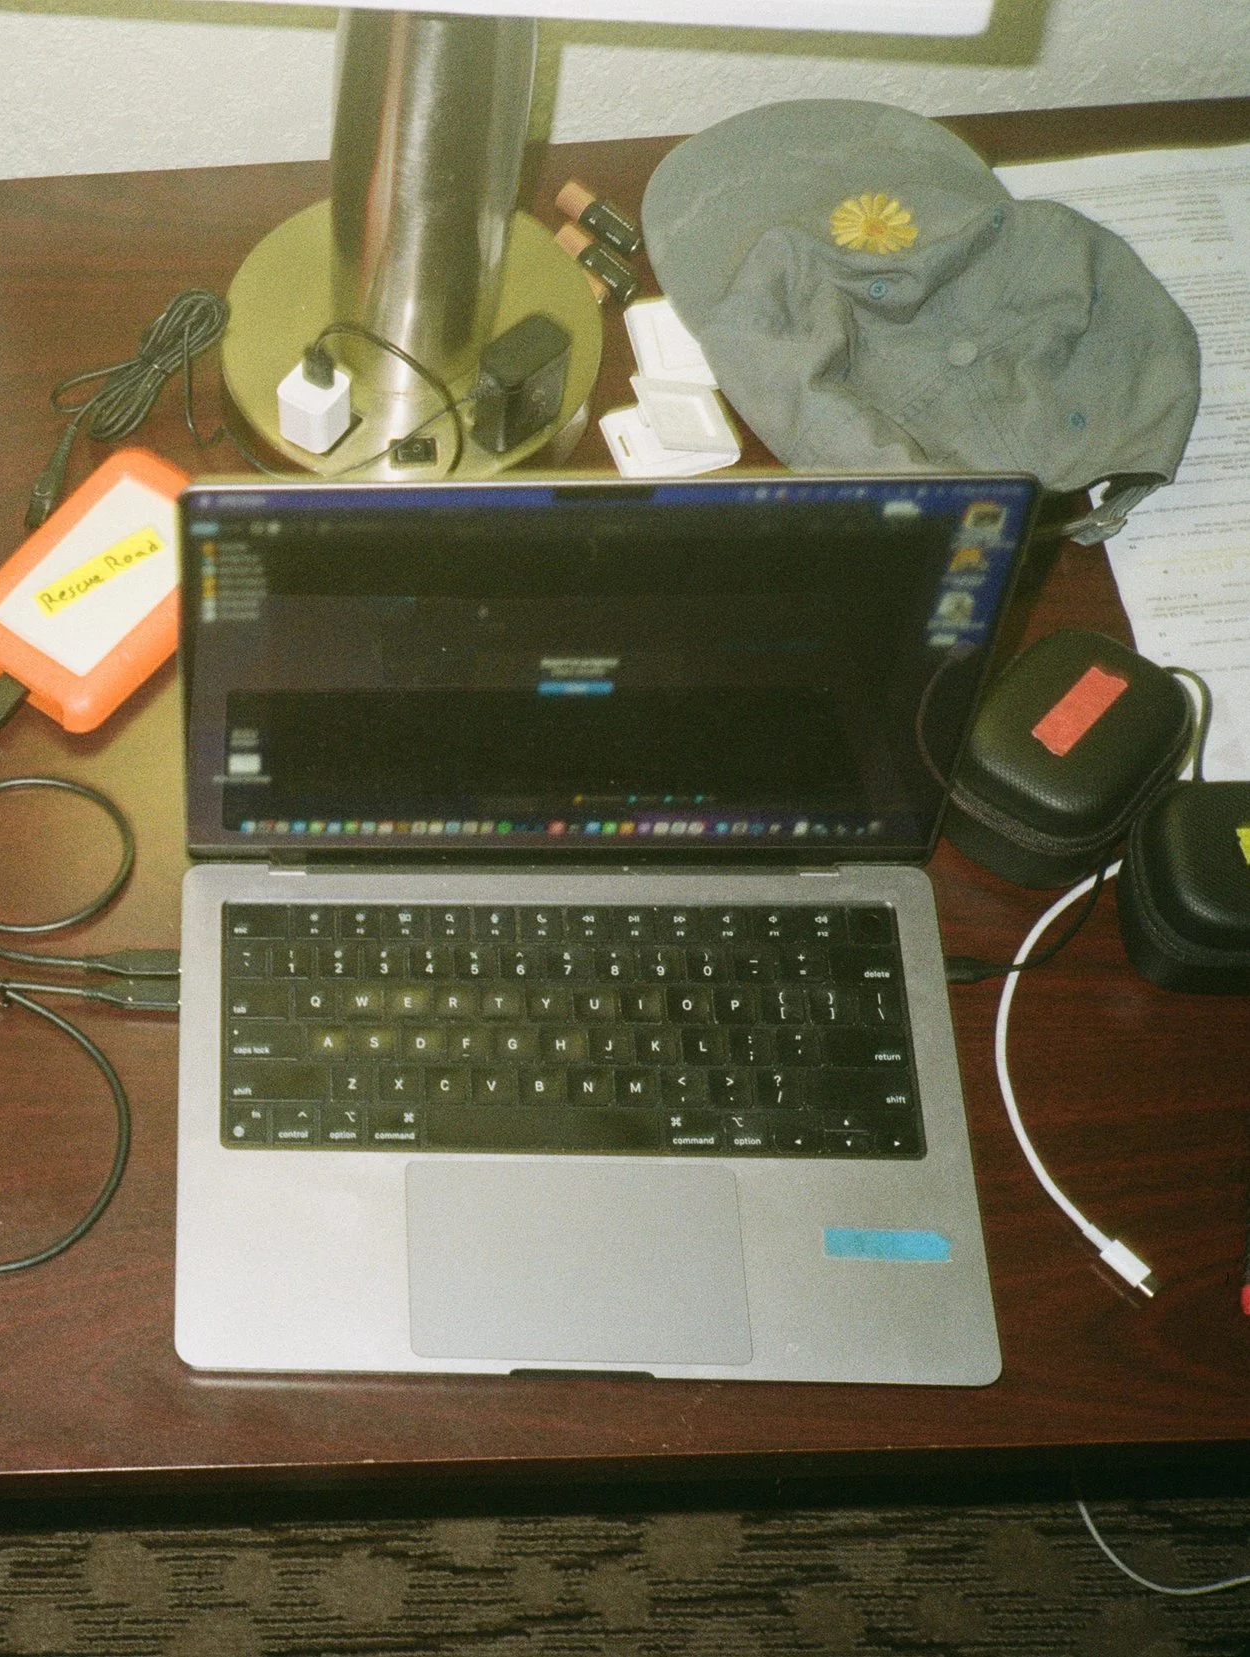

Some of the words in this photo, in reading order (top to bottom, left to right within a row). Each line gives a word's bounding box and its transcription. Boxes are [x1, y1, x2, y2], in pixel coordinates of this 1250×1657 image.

[40, 574, 105, 612] Rescue
[104, 540, 159, 571] Road
[288, 963, 295, 973] 1
[334, 962, 343, 974] 2
[380, 963, 388, 974] 3
[426, 963, 434, 974] 4
[470, 964, 479, 974] 5
[516, 964, 525, 975] 6
[563, 964, 572, 976] 7
[610, 964, 620, 976] 8
[656, 965, 665, 976] 9
[703, 965, 712, 976] 0
[233, 1006, 246, 1014] tab
[310, 996, 321, 1008] Q
[355, 996, 369, 1008] W
[404, 996, 412, 1008] E
[448, 996, 458, 1008] R
[494, 998, 503, 1008] T
[542, 998, 550, 1009] Y
[589, 998, 599, 1010] U
[682, 1000, 692, 1010] O
[730, 1000, 740, 1011] P
[323, 1036, 334, 1048] A
[370, 1036, 380, 1048] S
[416, 1037, 426, 1049] D
[462, 1038, 470, 1049] F
[508, 1038, 518, 1050] G
[555, 1039, 566, 1050] H
[605, 1040, 612, 1051] J
[651, 1040, 660, 1052] K
[700, 1040, 708, 1052] L
[233, 1046, 252, 1056] caps
[252, 1046, 270, 1054] lock
[874, 1053, 901, 1061] return
[348, 1078, 357, 1090] Z
[394, 1078, 404, 1090] X
[440, 1079, 450, 1091] C
[486, 1080, 496, 1092] V
[535, 1080, 544, 1092] B
[583, 1082, 594, 1093] N
[630, 1082, 642, 1094] M
[774, 1075, 782, 1086] ?
[233, 1086, 252, 1096] shift
[886, 1095, 906, 1104] shift
[251, 1110, 261, 1119] fn
[278, 1130, 308, 1139] control
[329, 1131, 356, 1140] option
[374, 1132, 416, 1140] command
[672, 1136, 714, 1145] command
[734, 1137, 762, 1146] option
